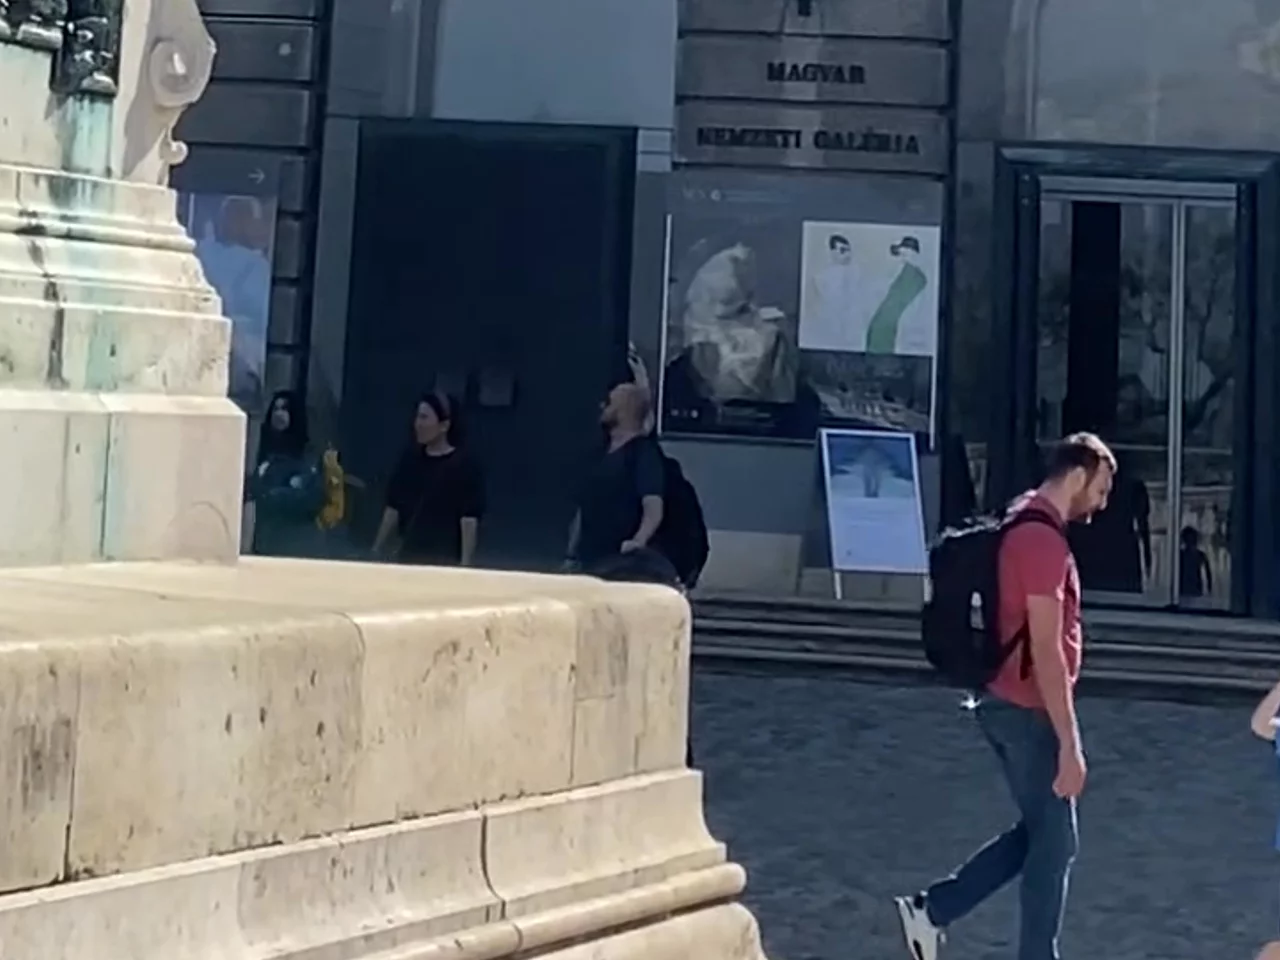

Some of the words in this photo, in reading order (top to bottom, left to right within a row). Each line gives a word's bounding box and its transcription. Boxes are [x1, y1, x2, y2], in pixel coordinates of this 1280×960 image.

[766, 62, 865, 84] MAGYAR
[697, 127, 802, 149] NEMZETI
[813, 126, 919, 153] GALÉRIA
